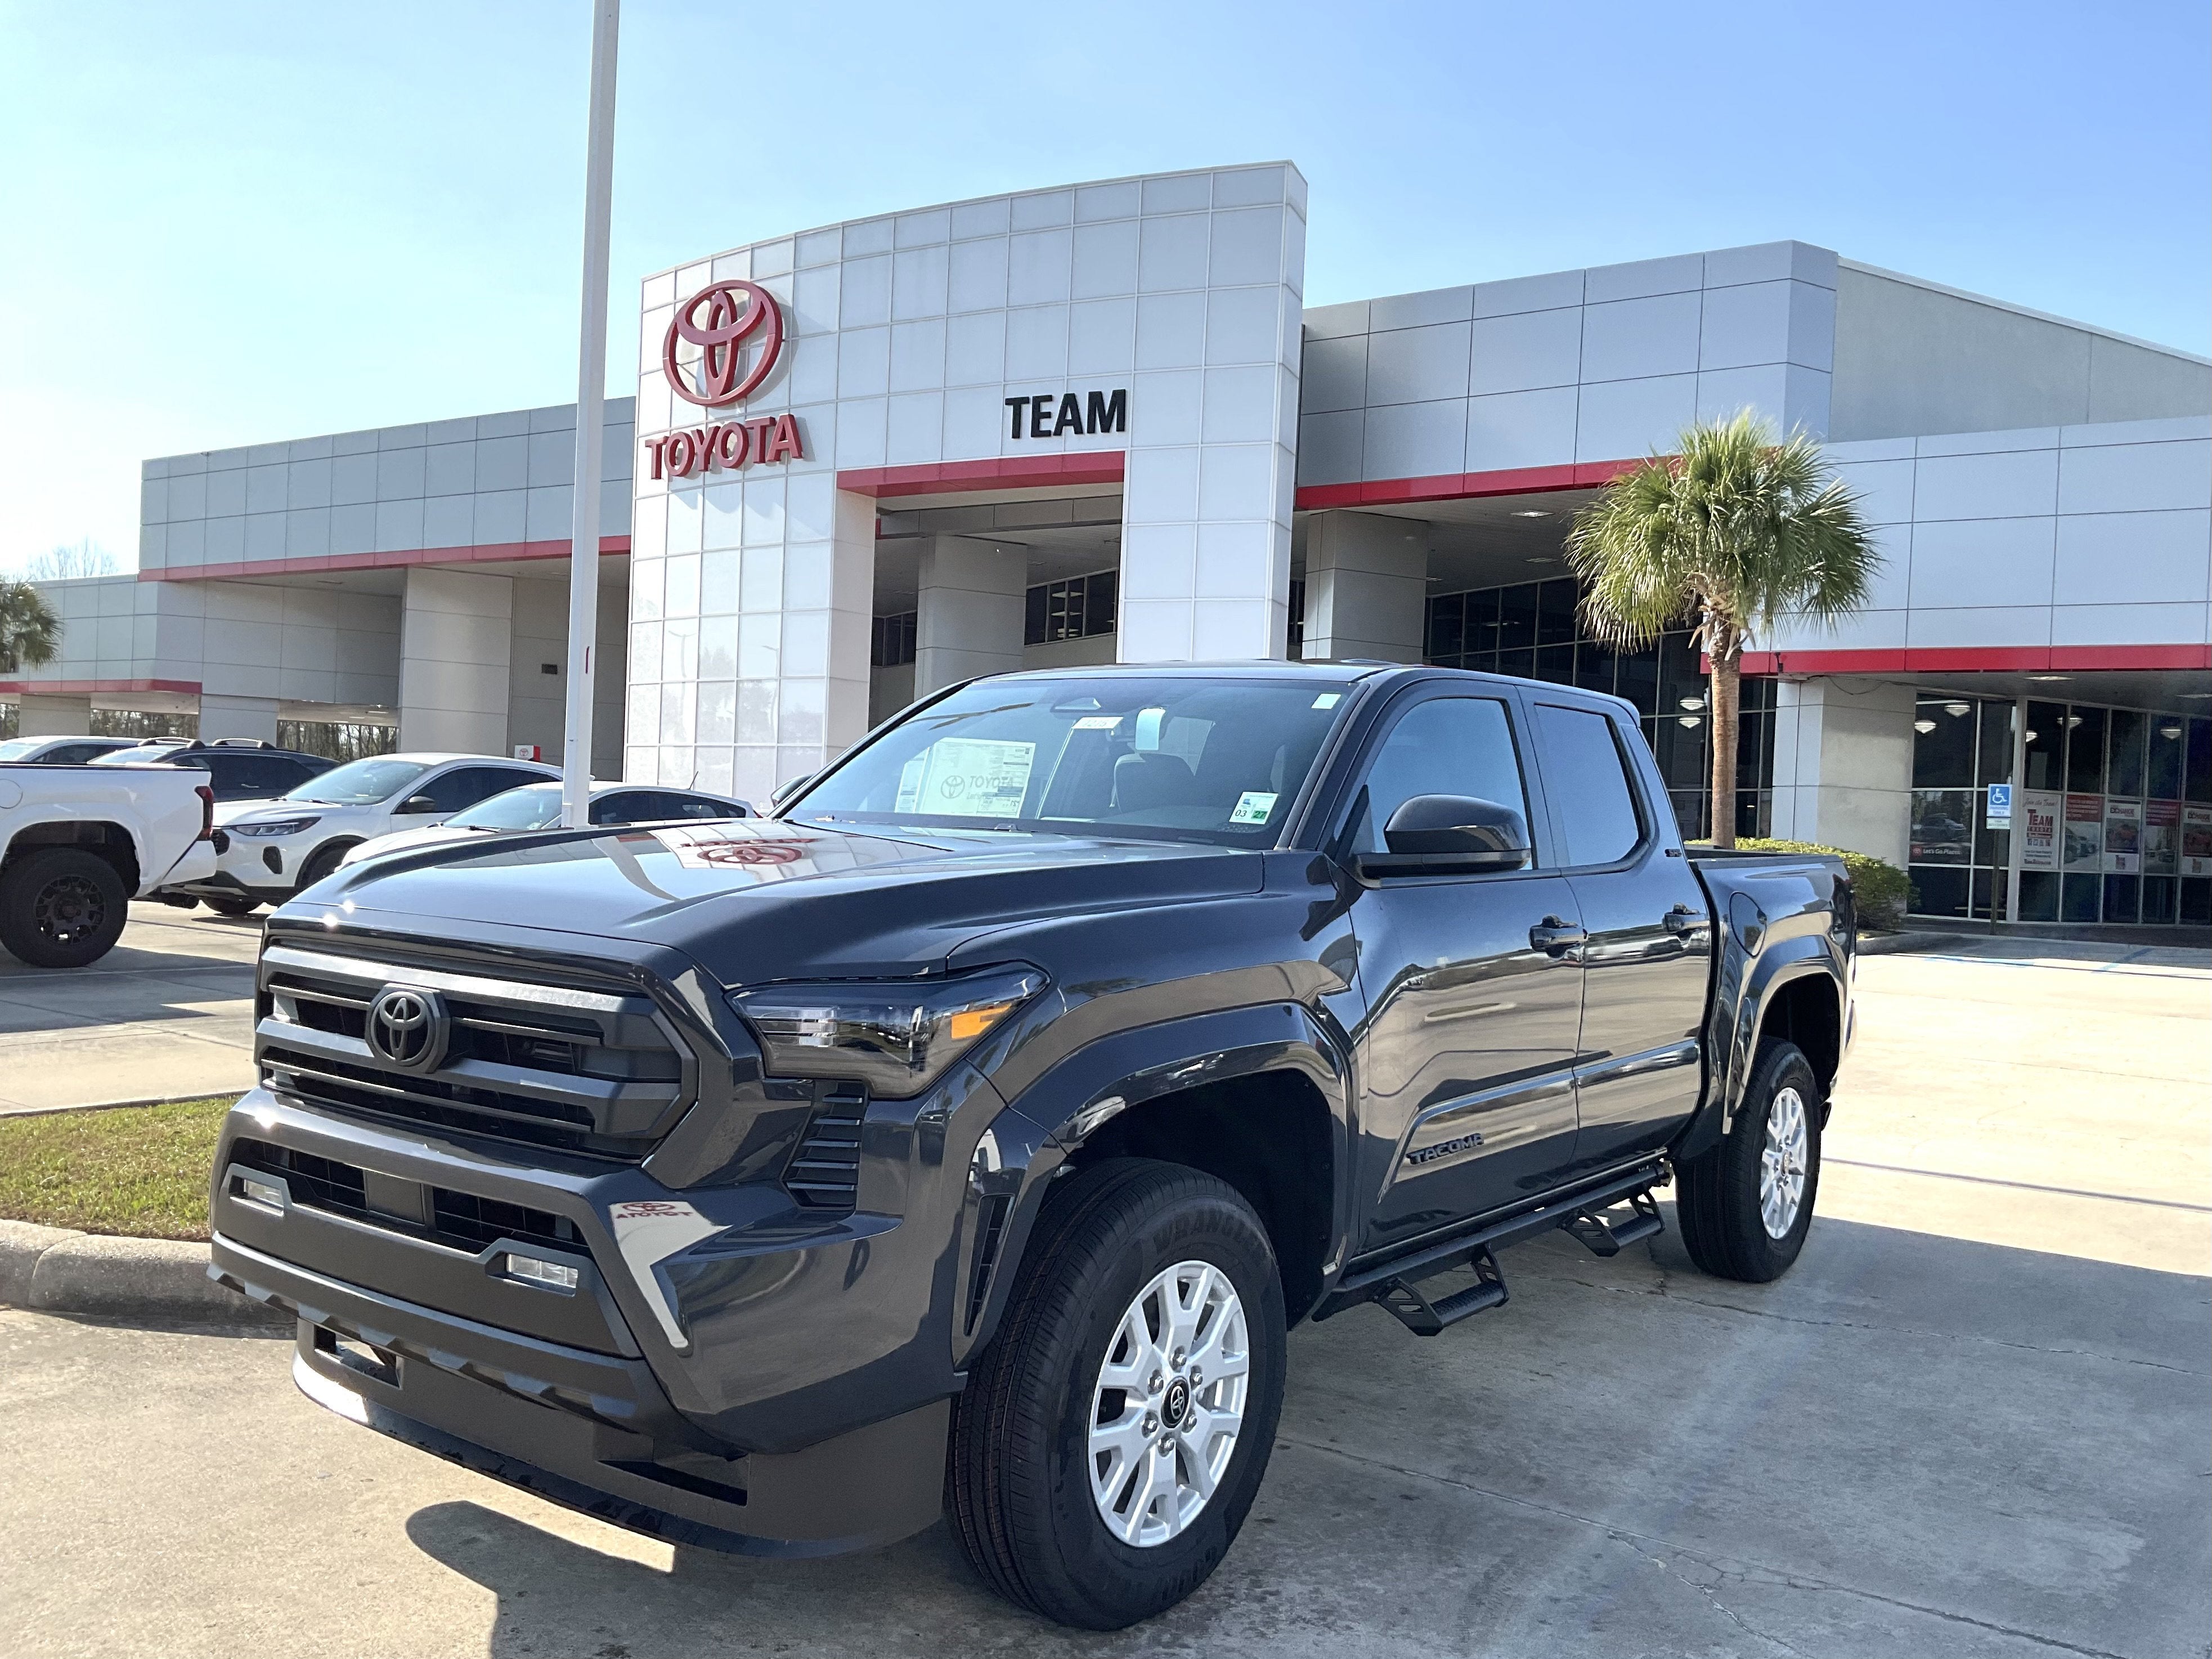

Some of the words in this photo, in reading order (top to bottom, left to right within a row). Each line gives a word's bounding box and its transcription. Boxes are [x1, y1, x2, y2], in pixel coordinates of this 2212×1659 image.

[1005, 389, 1127, 439] TEAM
[644, 413, 803, 480] TOYOTA
[2027, 809, 2053, 827] TEAM
[1407, 1133, 1484, 1165] TACOMA
